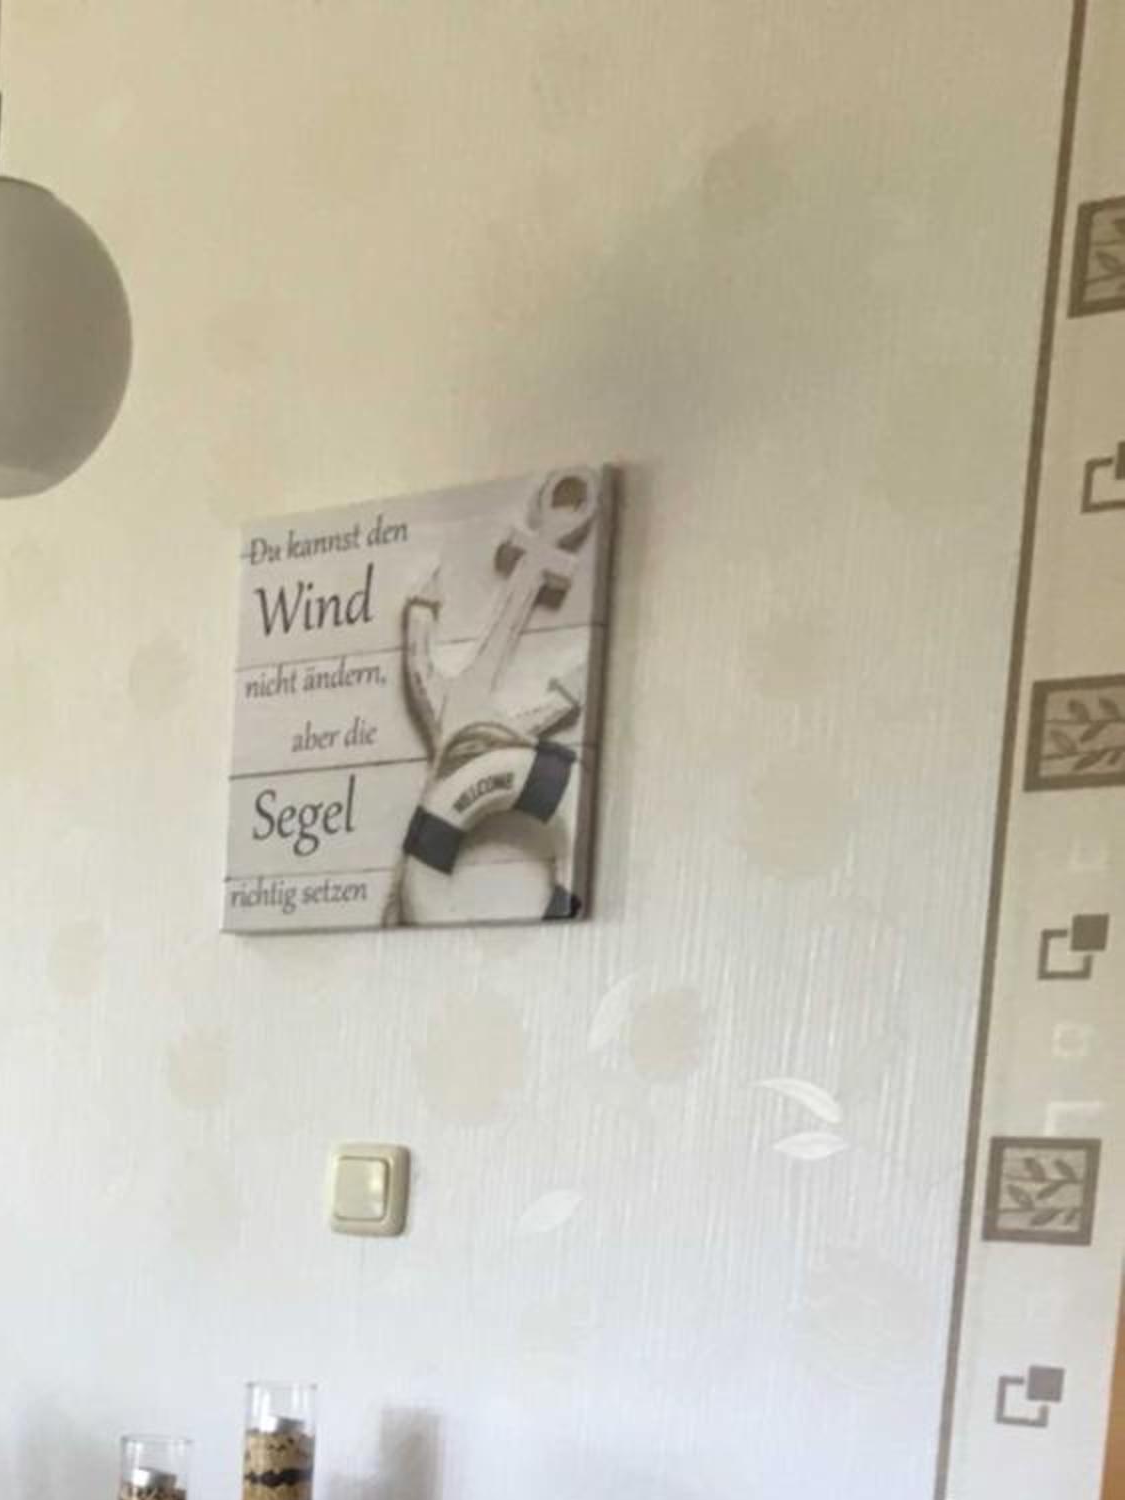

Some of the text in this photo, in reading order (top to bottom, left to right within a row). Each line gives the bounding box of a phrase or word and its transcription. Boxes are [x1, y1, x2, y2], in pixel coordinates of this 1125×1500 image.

[250, 513, 408, 565] Du kannst den
[254, 562, 373, 637] Wind
[245, 662, 298, 699] nicht
[291, 715, 377, 752] aber die
[252, 774, 356, 857] Segel
[230, 875, 367, 915] richtig setzen
